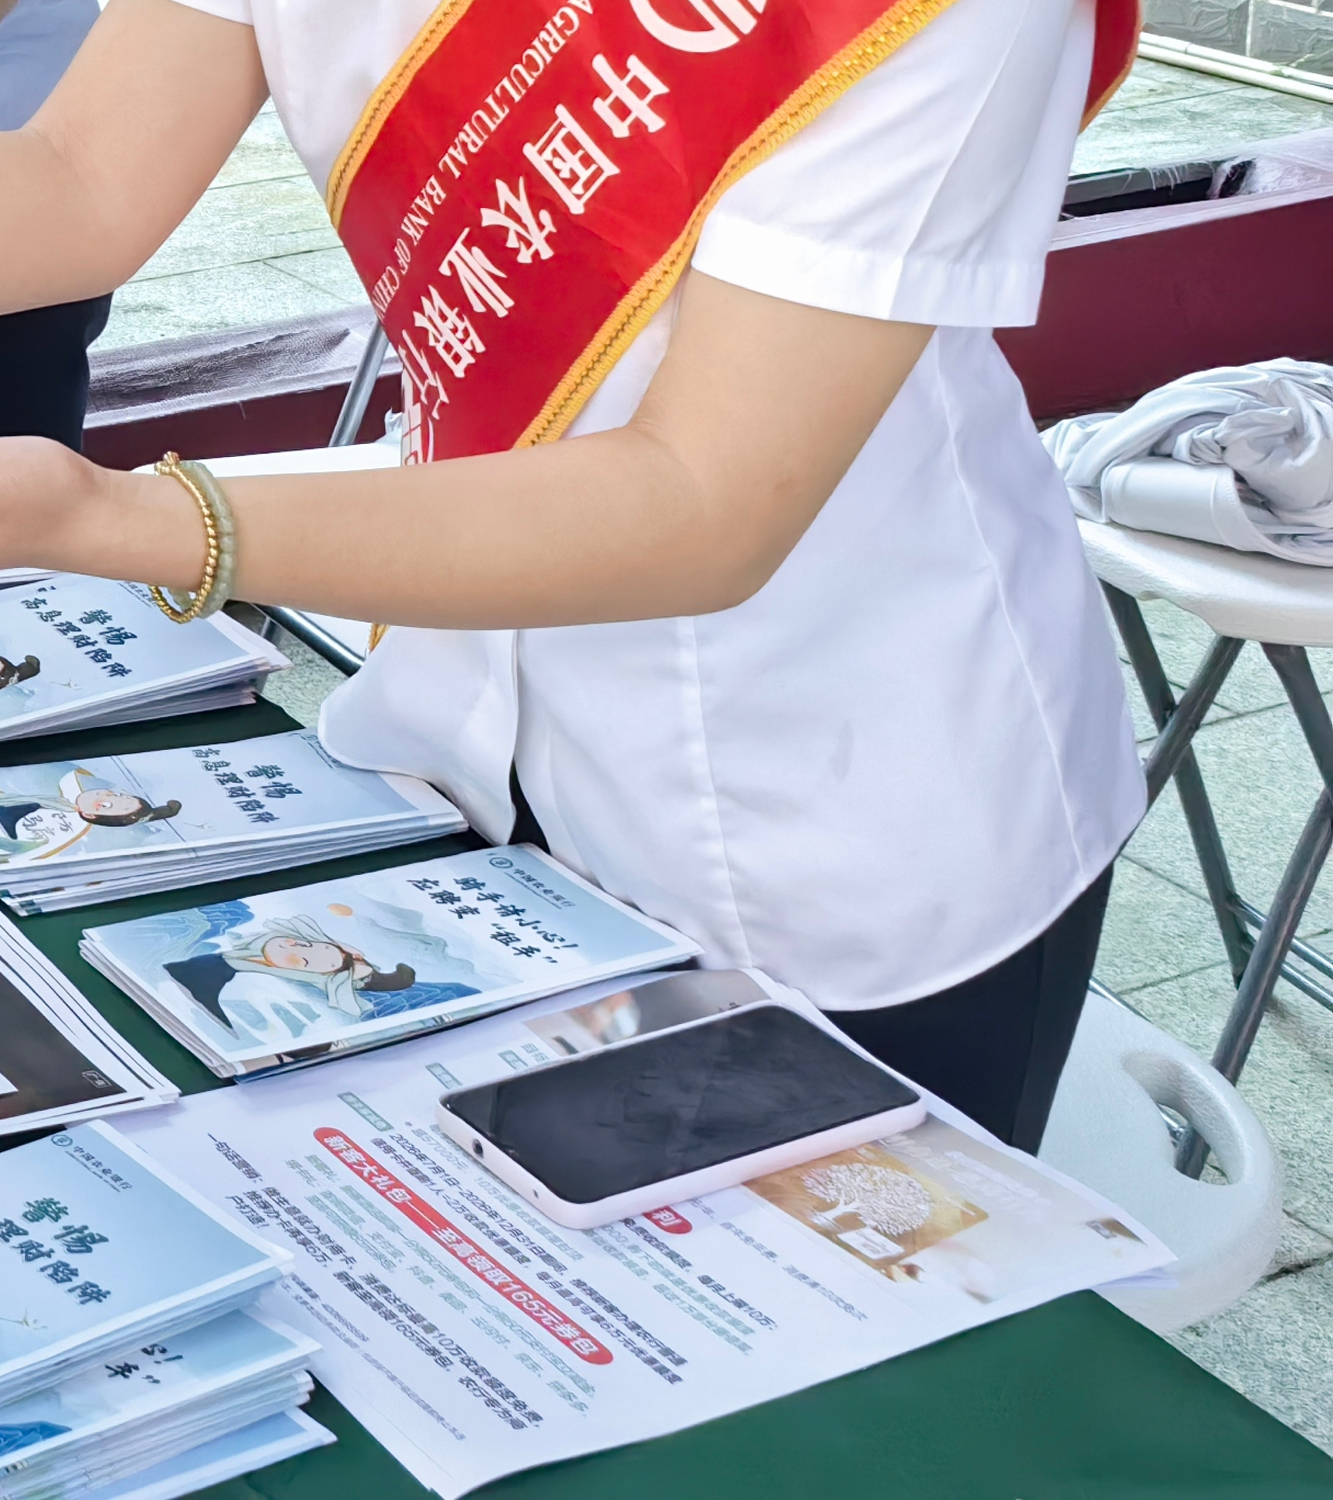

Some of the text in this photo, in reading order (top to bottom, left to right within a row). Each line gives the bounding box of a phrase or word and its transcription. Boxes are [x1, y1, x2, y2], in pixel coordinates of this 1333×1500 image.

[397, 177, 447, 247] BANK
[399, 53, 670, 421] 中国农业银行
[393, 238, 411, 276] OF
[20, 596, 133, 679] 高息理财陷阱
[78, 607, 138, 646] 警惕
[191, 747, 281, 825] 高息理财陷阱
[246, 764, 303, 800] 警惕
[19, 1197, 110, 1255] 警惕
